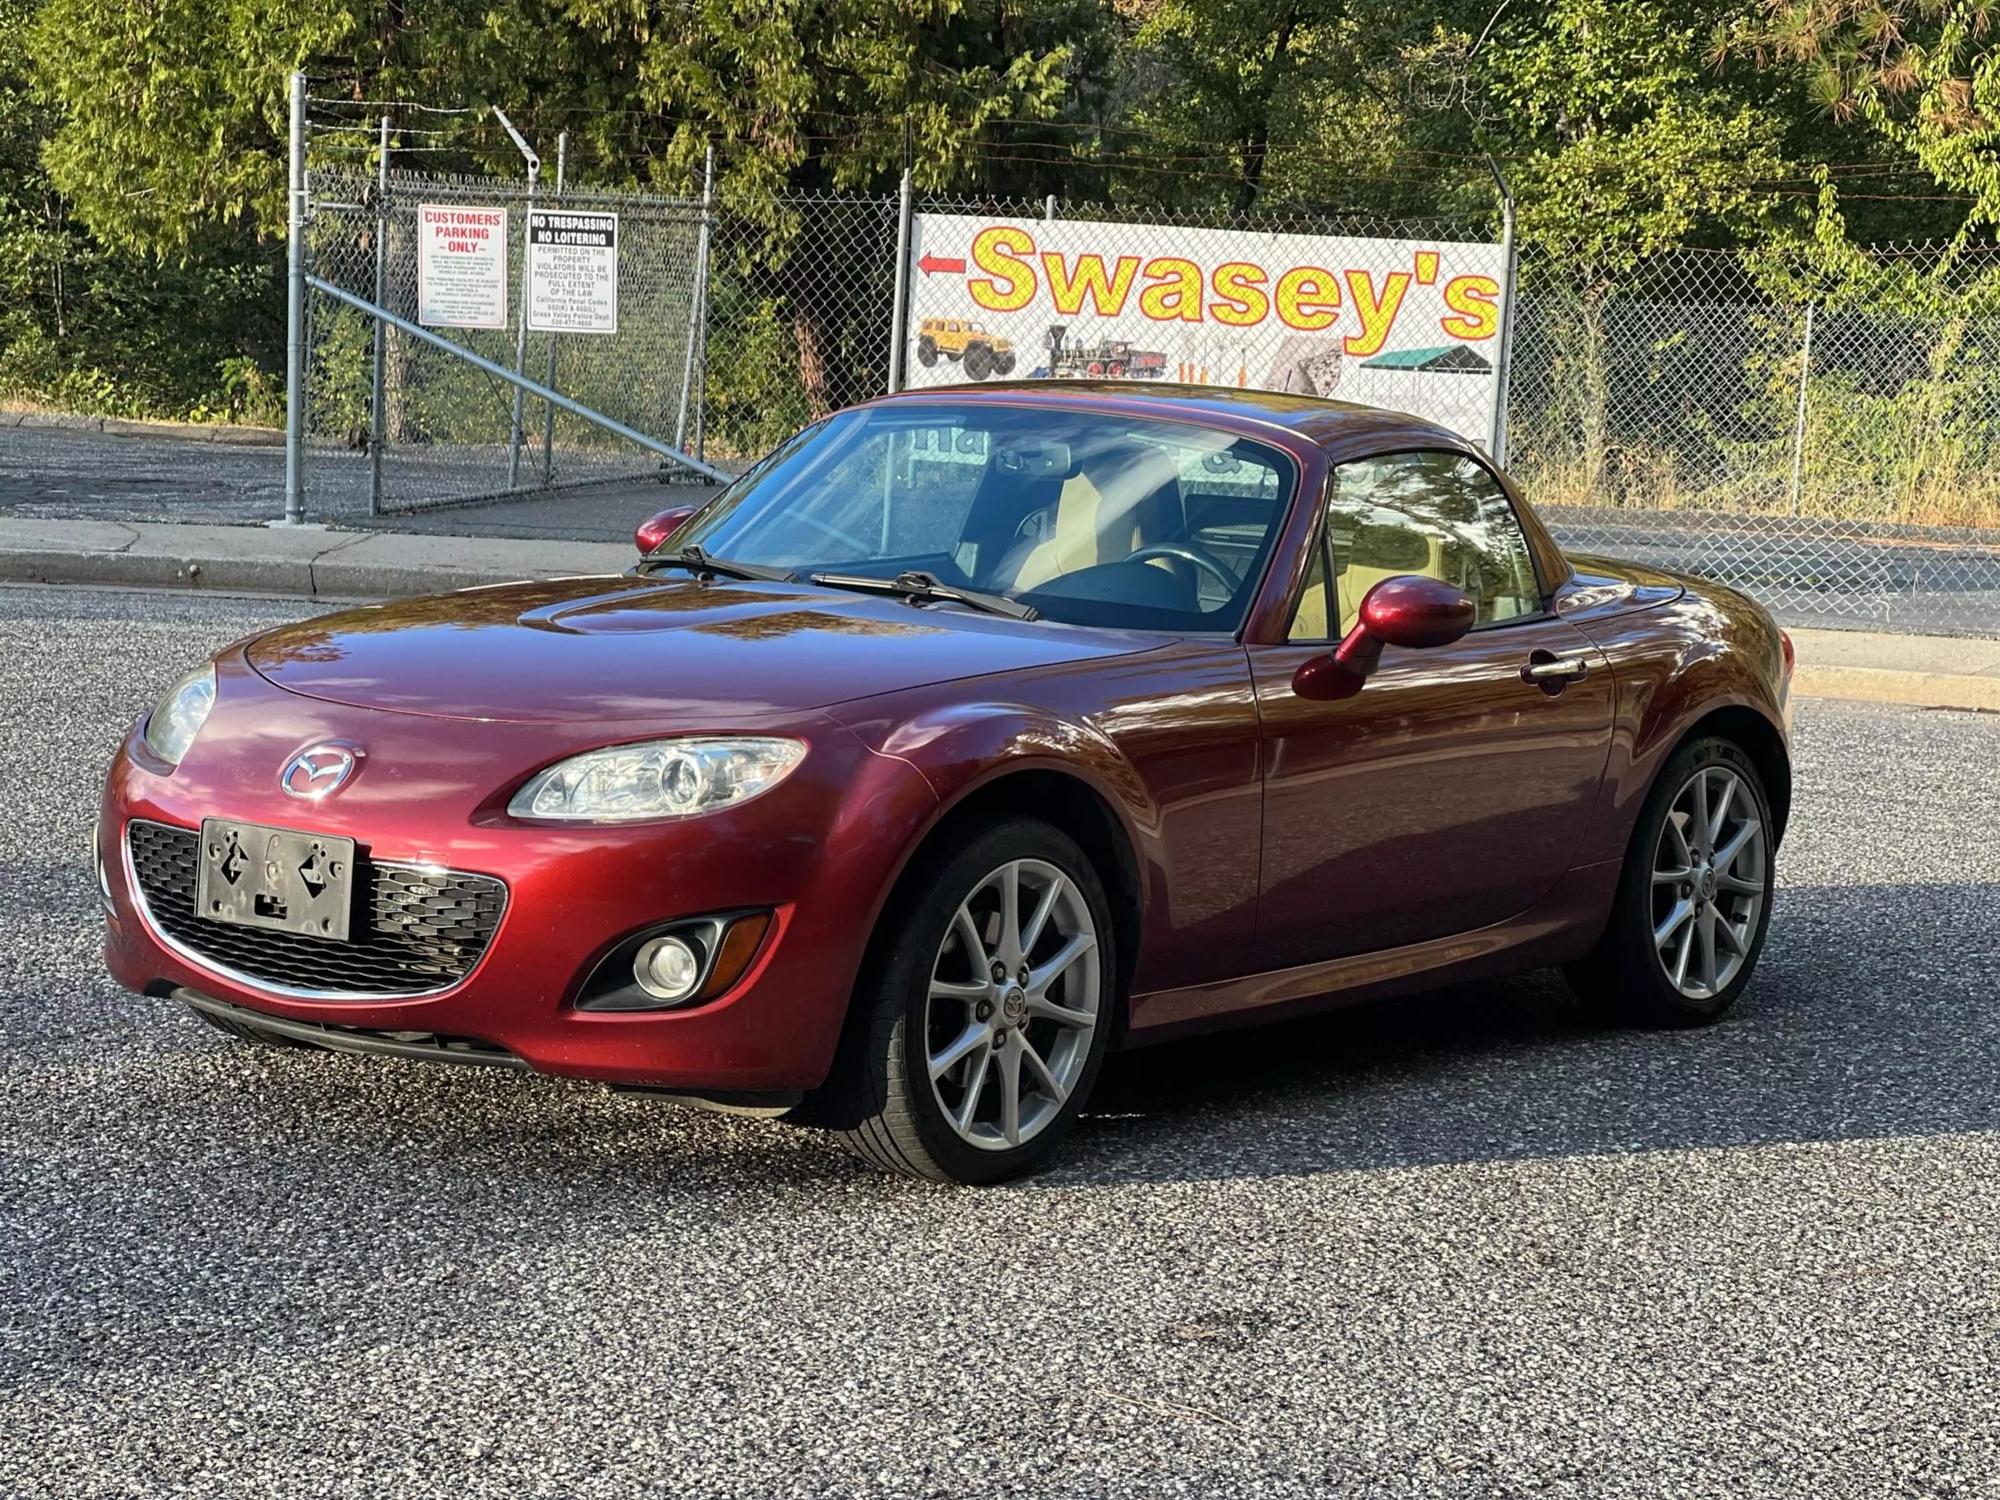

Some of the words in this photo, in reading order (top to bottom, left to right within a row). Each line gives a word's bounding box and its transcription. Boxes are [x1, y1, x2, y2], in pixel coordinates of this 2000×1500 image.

[424, 211, 500, 226] CUSTOMERS
[532, 215, 546, 228] NO
[547, 216, 613, 231] TRESPASSING
[435, 226, 490, 240] PARKING
[538, 230, 552, 243] NO
[554, 231, 606, 245] LOITERING
[448, 240, 478, 253] ONLY
[538, 246, 578, 255] PERMITTED
[592, 248, 606, 256] THE
[553, 255, 591, 264] PROPERTY
[537, 262, 576, 271] VIOLATORS
[578, 265, 595, 273] WILL
[597, 265, 607, 273] BE
[534, 270, 582, 280] PROSECUTED
[596, 273, 609, 281] THE
[548, 279, 566, 288] FULL
[568, 281, 595, 289] EXTENT
[550, 287, 559, 295] OF
[562, 288, 575, 296] THE
[578, 289, 593, 297] LAW
[967, 225, 1500, 358] Swasey's
[536, 296, 567, 304] California
[588, 298, 608, 306] Codes
